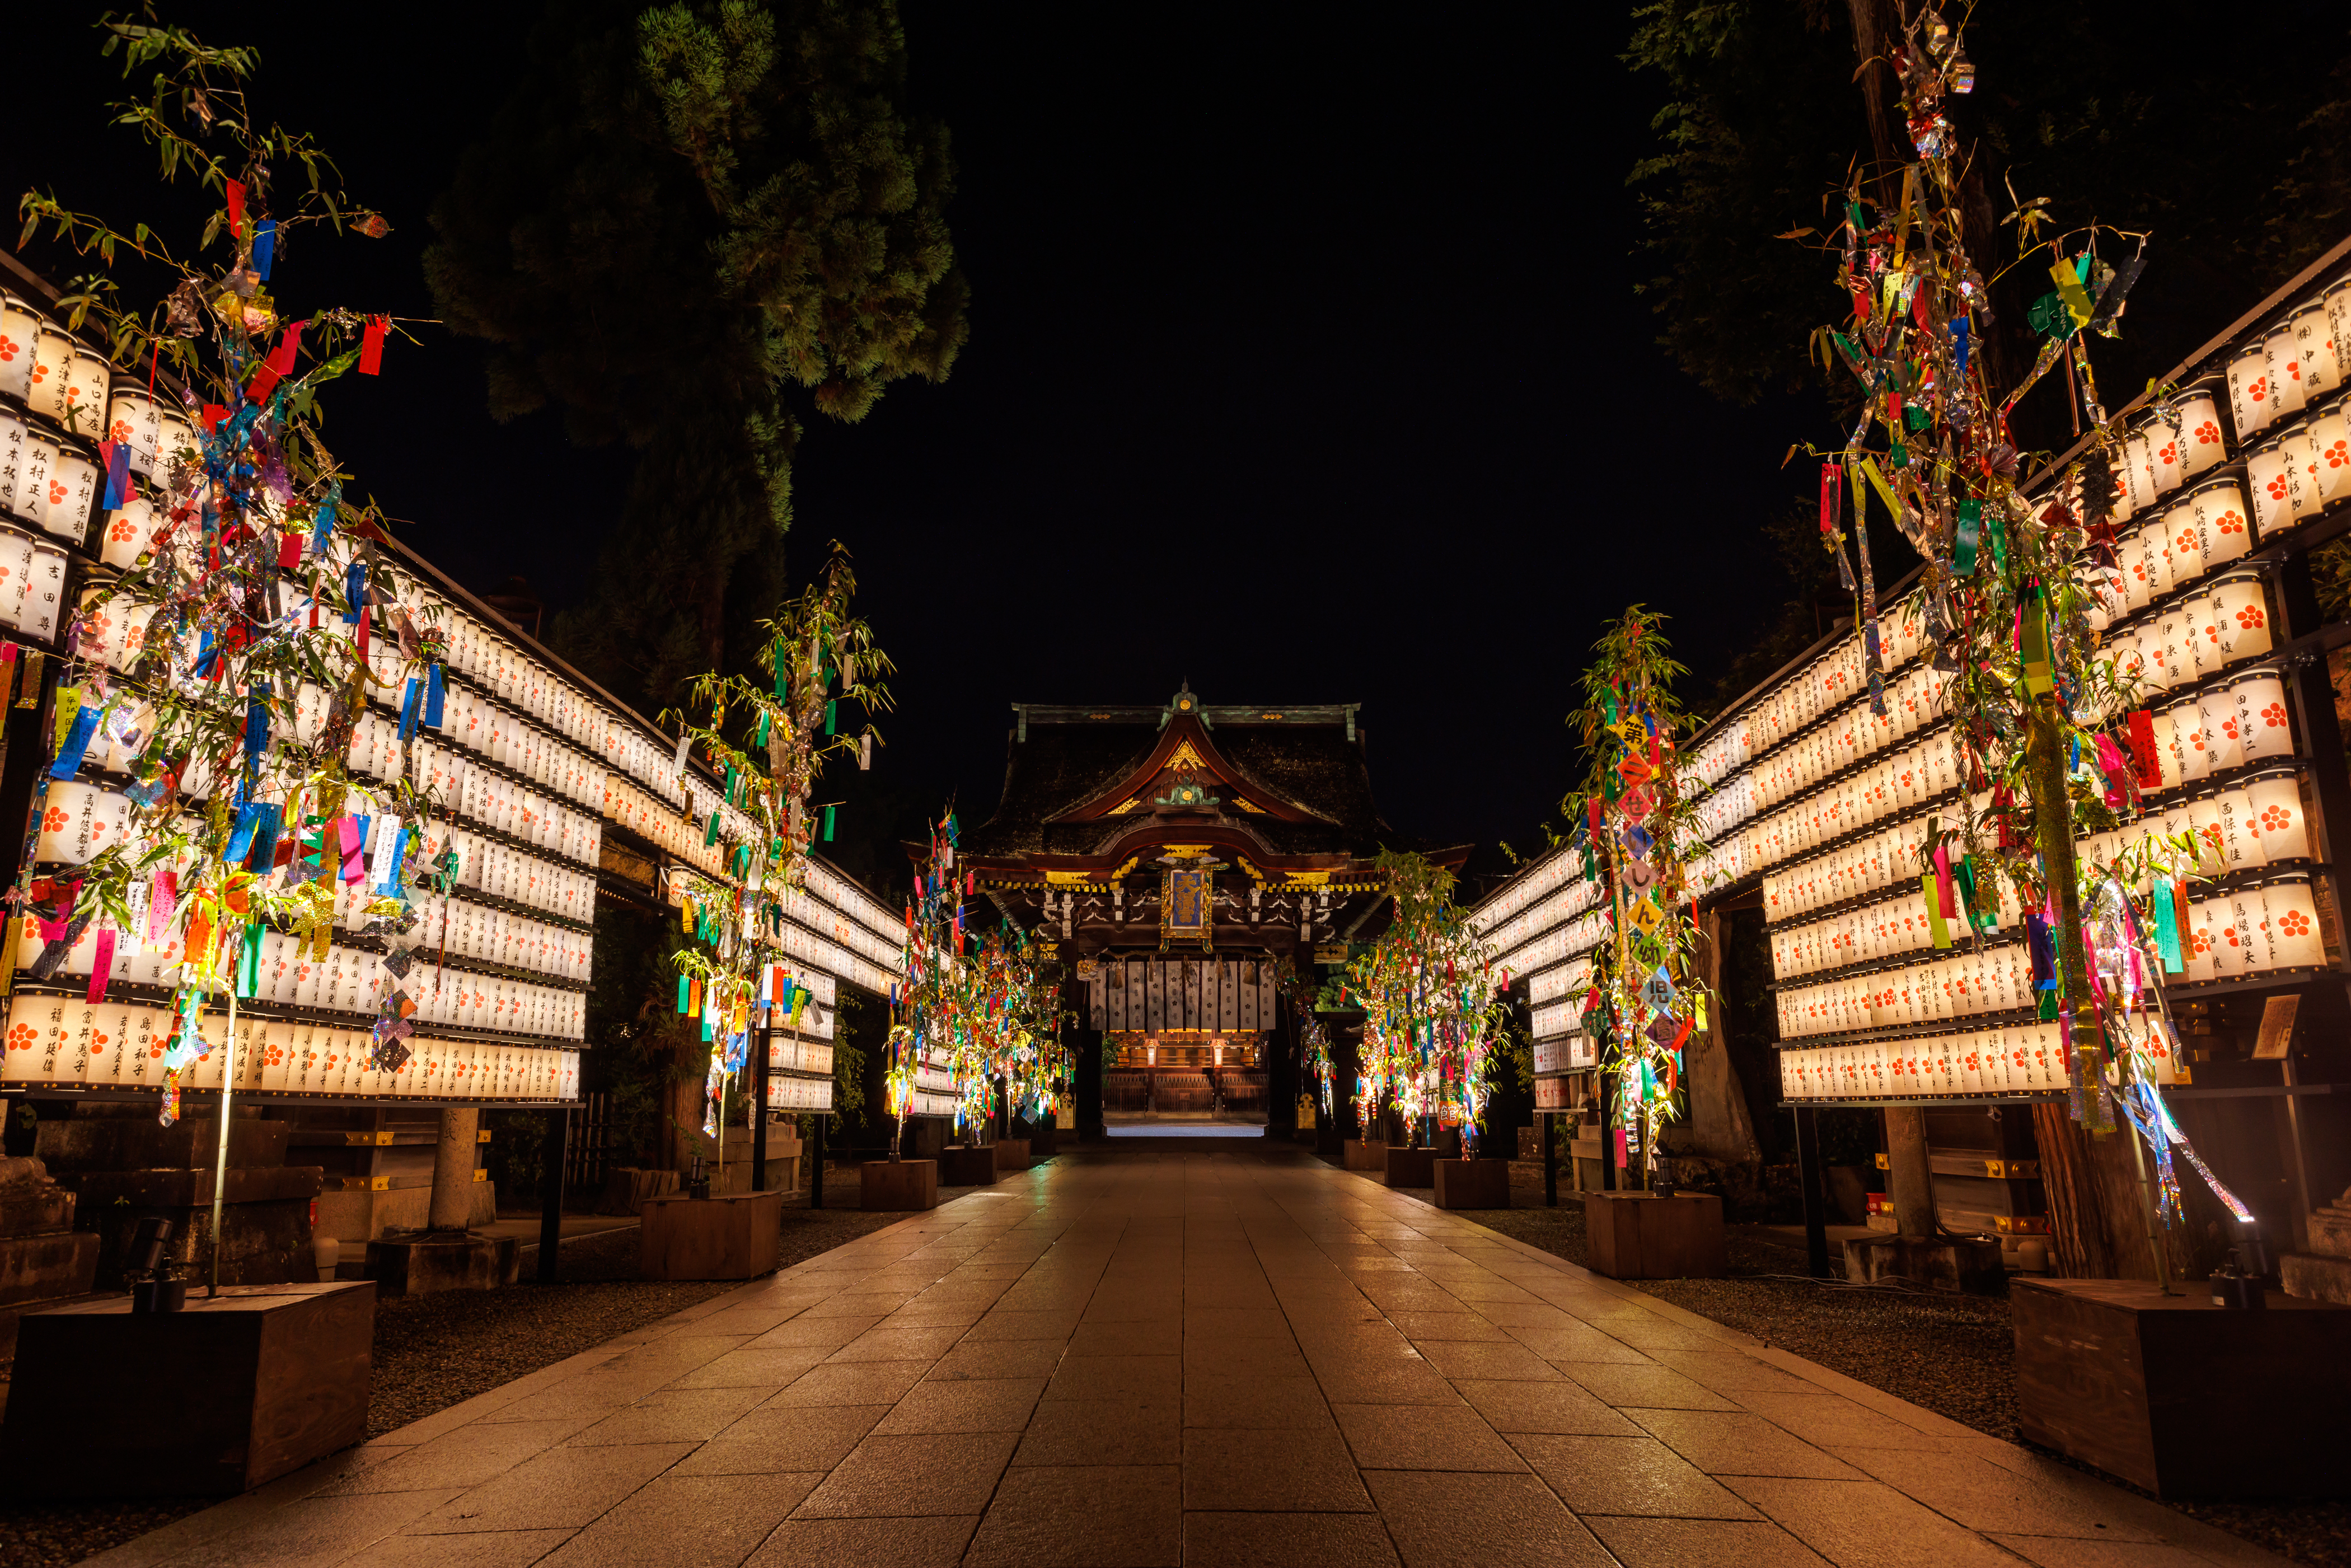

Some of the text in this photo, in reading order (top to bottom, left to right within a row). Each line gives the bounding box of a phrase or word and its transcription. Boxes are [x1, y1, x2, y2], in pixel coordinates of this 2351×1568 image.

[25, 448, 47, 515] 松村正人
[2236, 694, 2256, 752] 田中孝二
[154, 879, 163, 914] なりたいな
[2236, 902, 2256, 965] 馬場昭夫
[133, 1017, 151, 1076] 島田和子
